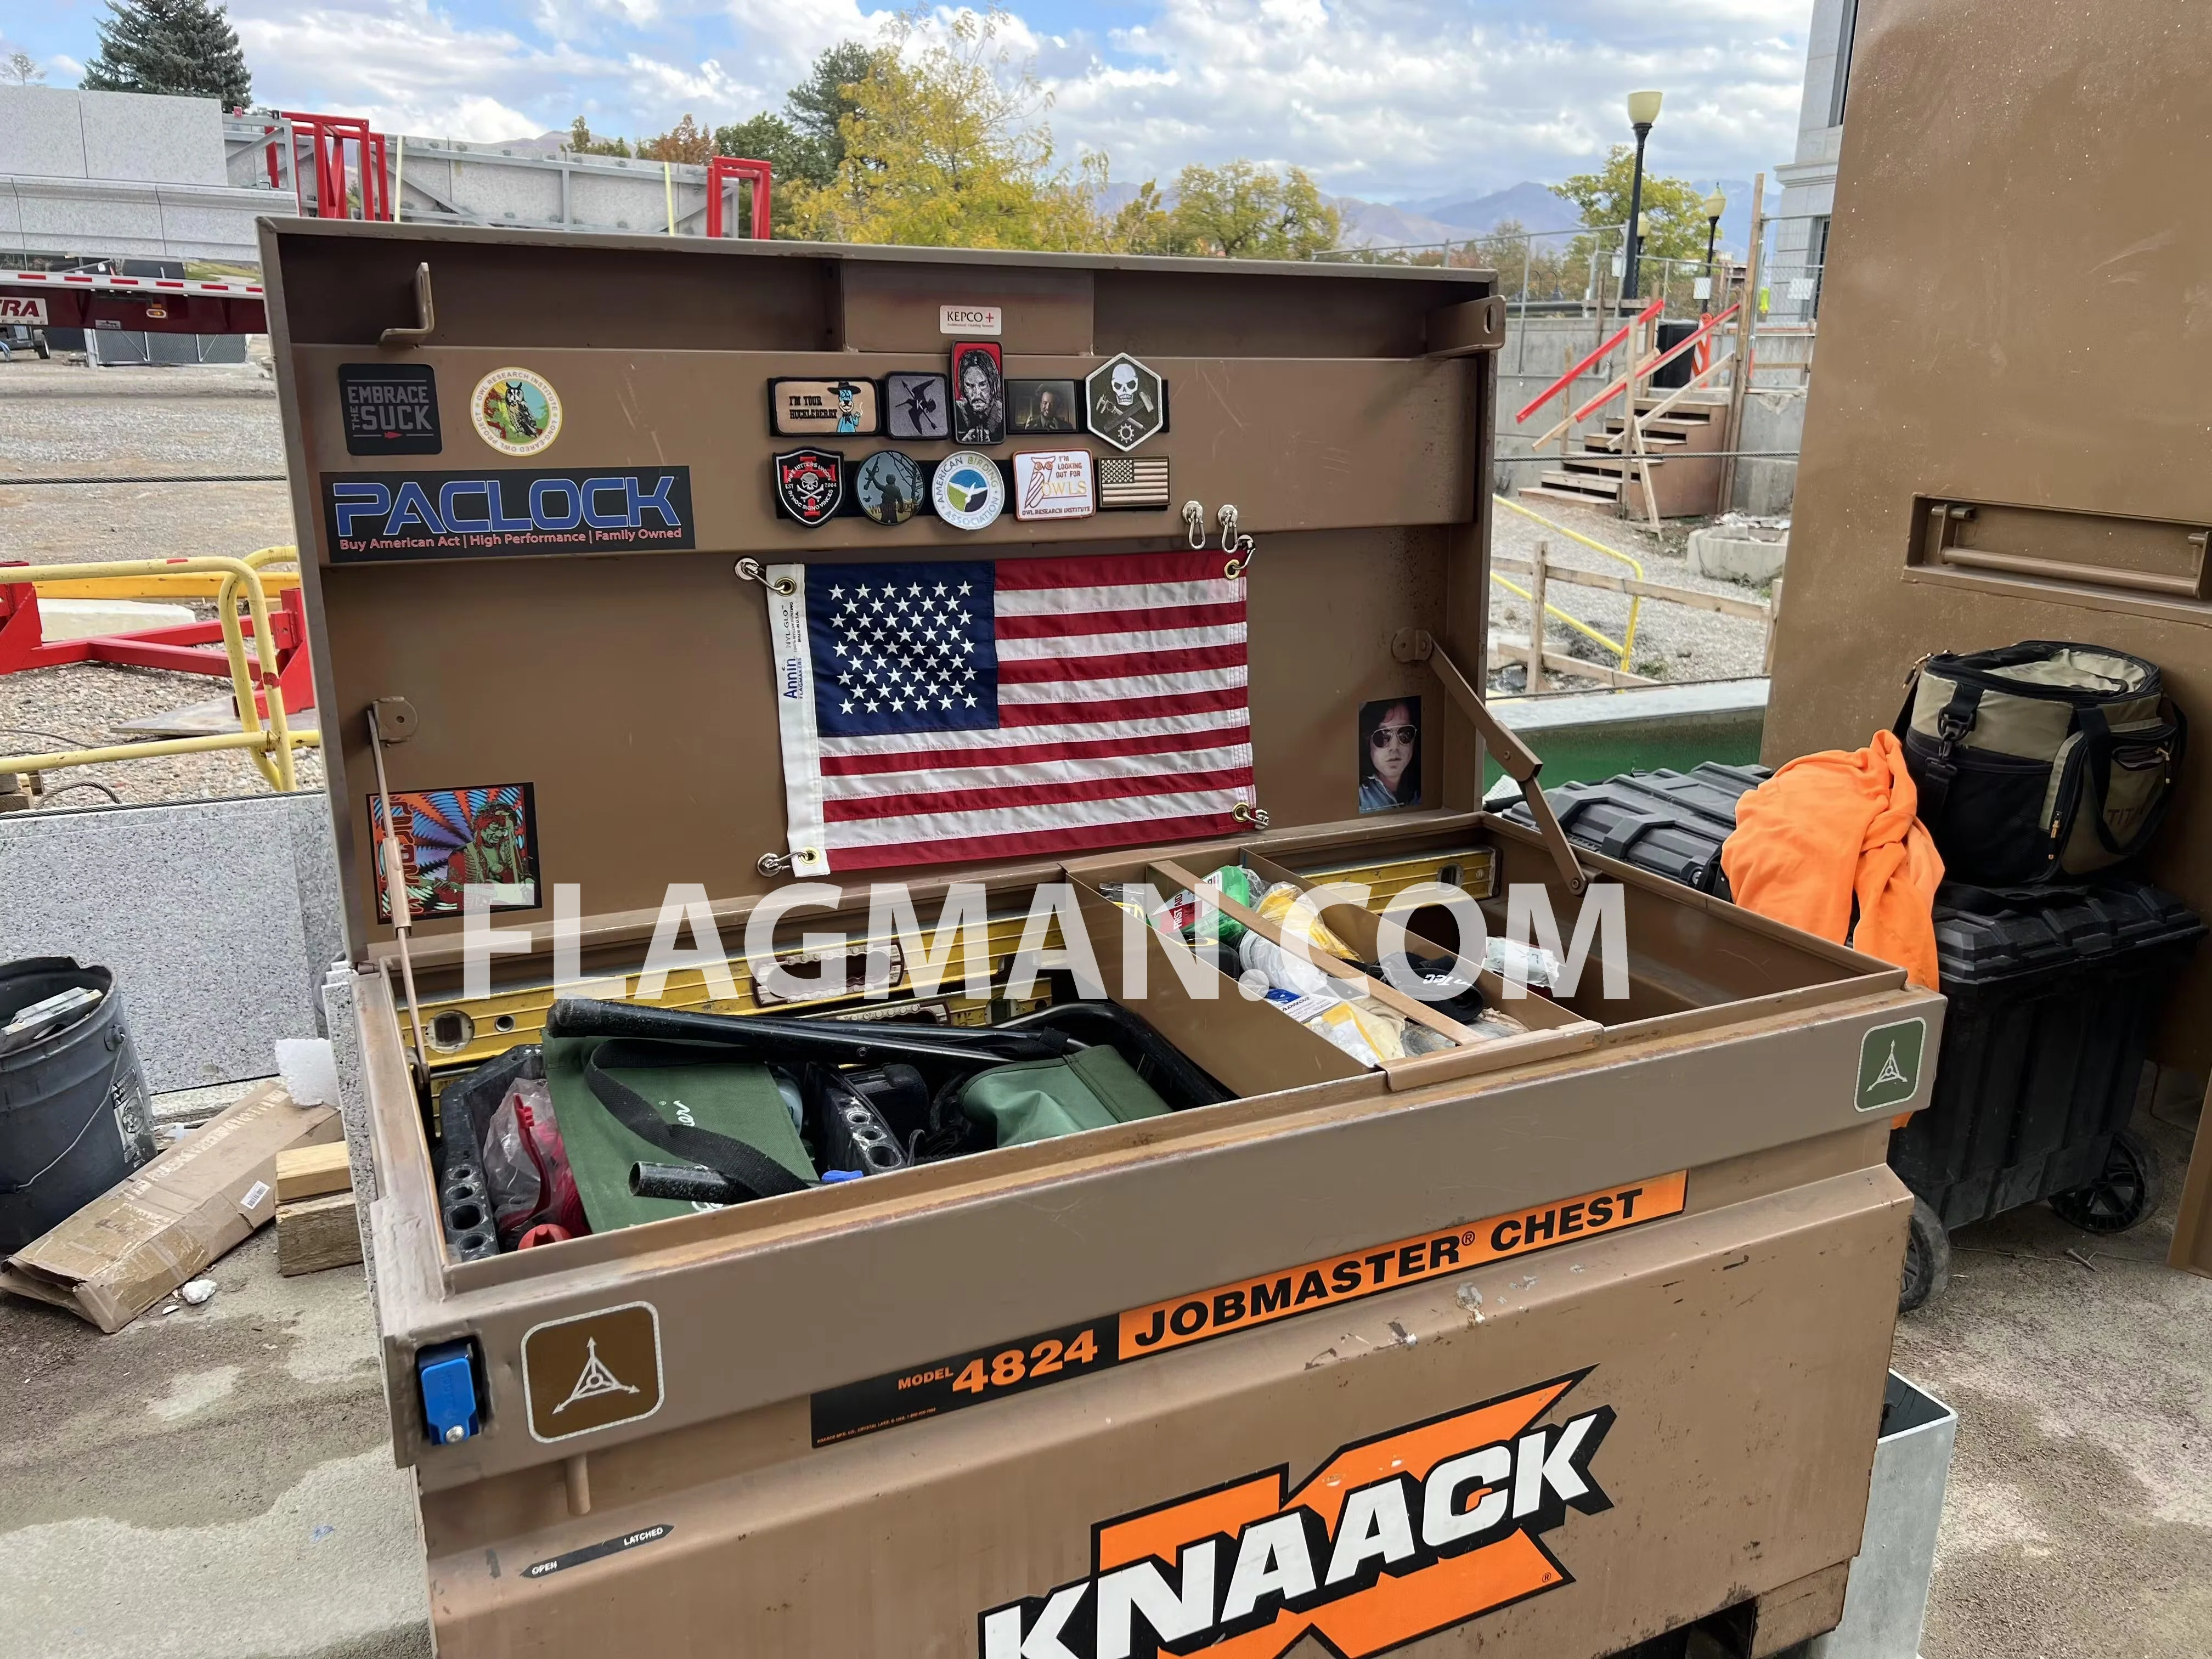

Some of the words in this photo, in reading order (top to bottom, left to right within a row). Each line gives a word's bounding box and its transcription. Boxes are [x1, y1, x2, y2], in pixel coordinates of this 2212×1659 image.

[0, 300, 40, 317] RA
[347, 386, 429, 403] EMBRACE
[476, 385, 488, 400] OWL
[487, 371, 529, 385] RESEARCH
[531, 377, 558, 410] INSTITUTE
[789, 396, 801, 405] I'M
[803, 396, 822, 406] YOUR
[789, 409, 838, 419] HUCKLEBERRY
[916, 399, 924, 410] K
[349, 406, 360, 430] THE
[360, 405, 433, 430] SUCK
[475, 413, 498, 444] PROJECT
[500, 442, 517, 452] OWL
[794, 462, 818, 471] HITTERS
[818, 465, 832, 481] UNION
[936, 456, 963, 503] AMERICAN
[968, 456, 998, 488] BIRDING
[1041, 480, 1087, 496] OWLS
[333, 476, 681, 537] PACLOCK
[944, 496, 1000, 525] ASSOCIATION
[339, 539, 366, 552] Buy
[369, 537, 435, 549] American
[438, 535, 460, 547] Act
[470, 533, 501, 548] High
[504, 532, 586, 544] Performance
[595, 529, 636, 541] Family
[638, 527, 682, 539] Owned
[782, 658, 797, 699] Annin
[1174, 893, 1183, 906] AID
[1173, 907, 1183, 930] FIRST
[1489, 1188, 1643, 1252] CHEST
[898, 1365, 955, 1391] MODEL
[952, 1329, 1098, 1395] 4824
[623, 1526, 664, 1546] LATCHED
[985, 1413, 1597, 1659] KNAACK
[531, 1560, 558, 1575] OPEN
